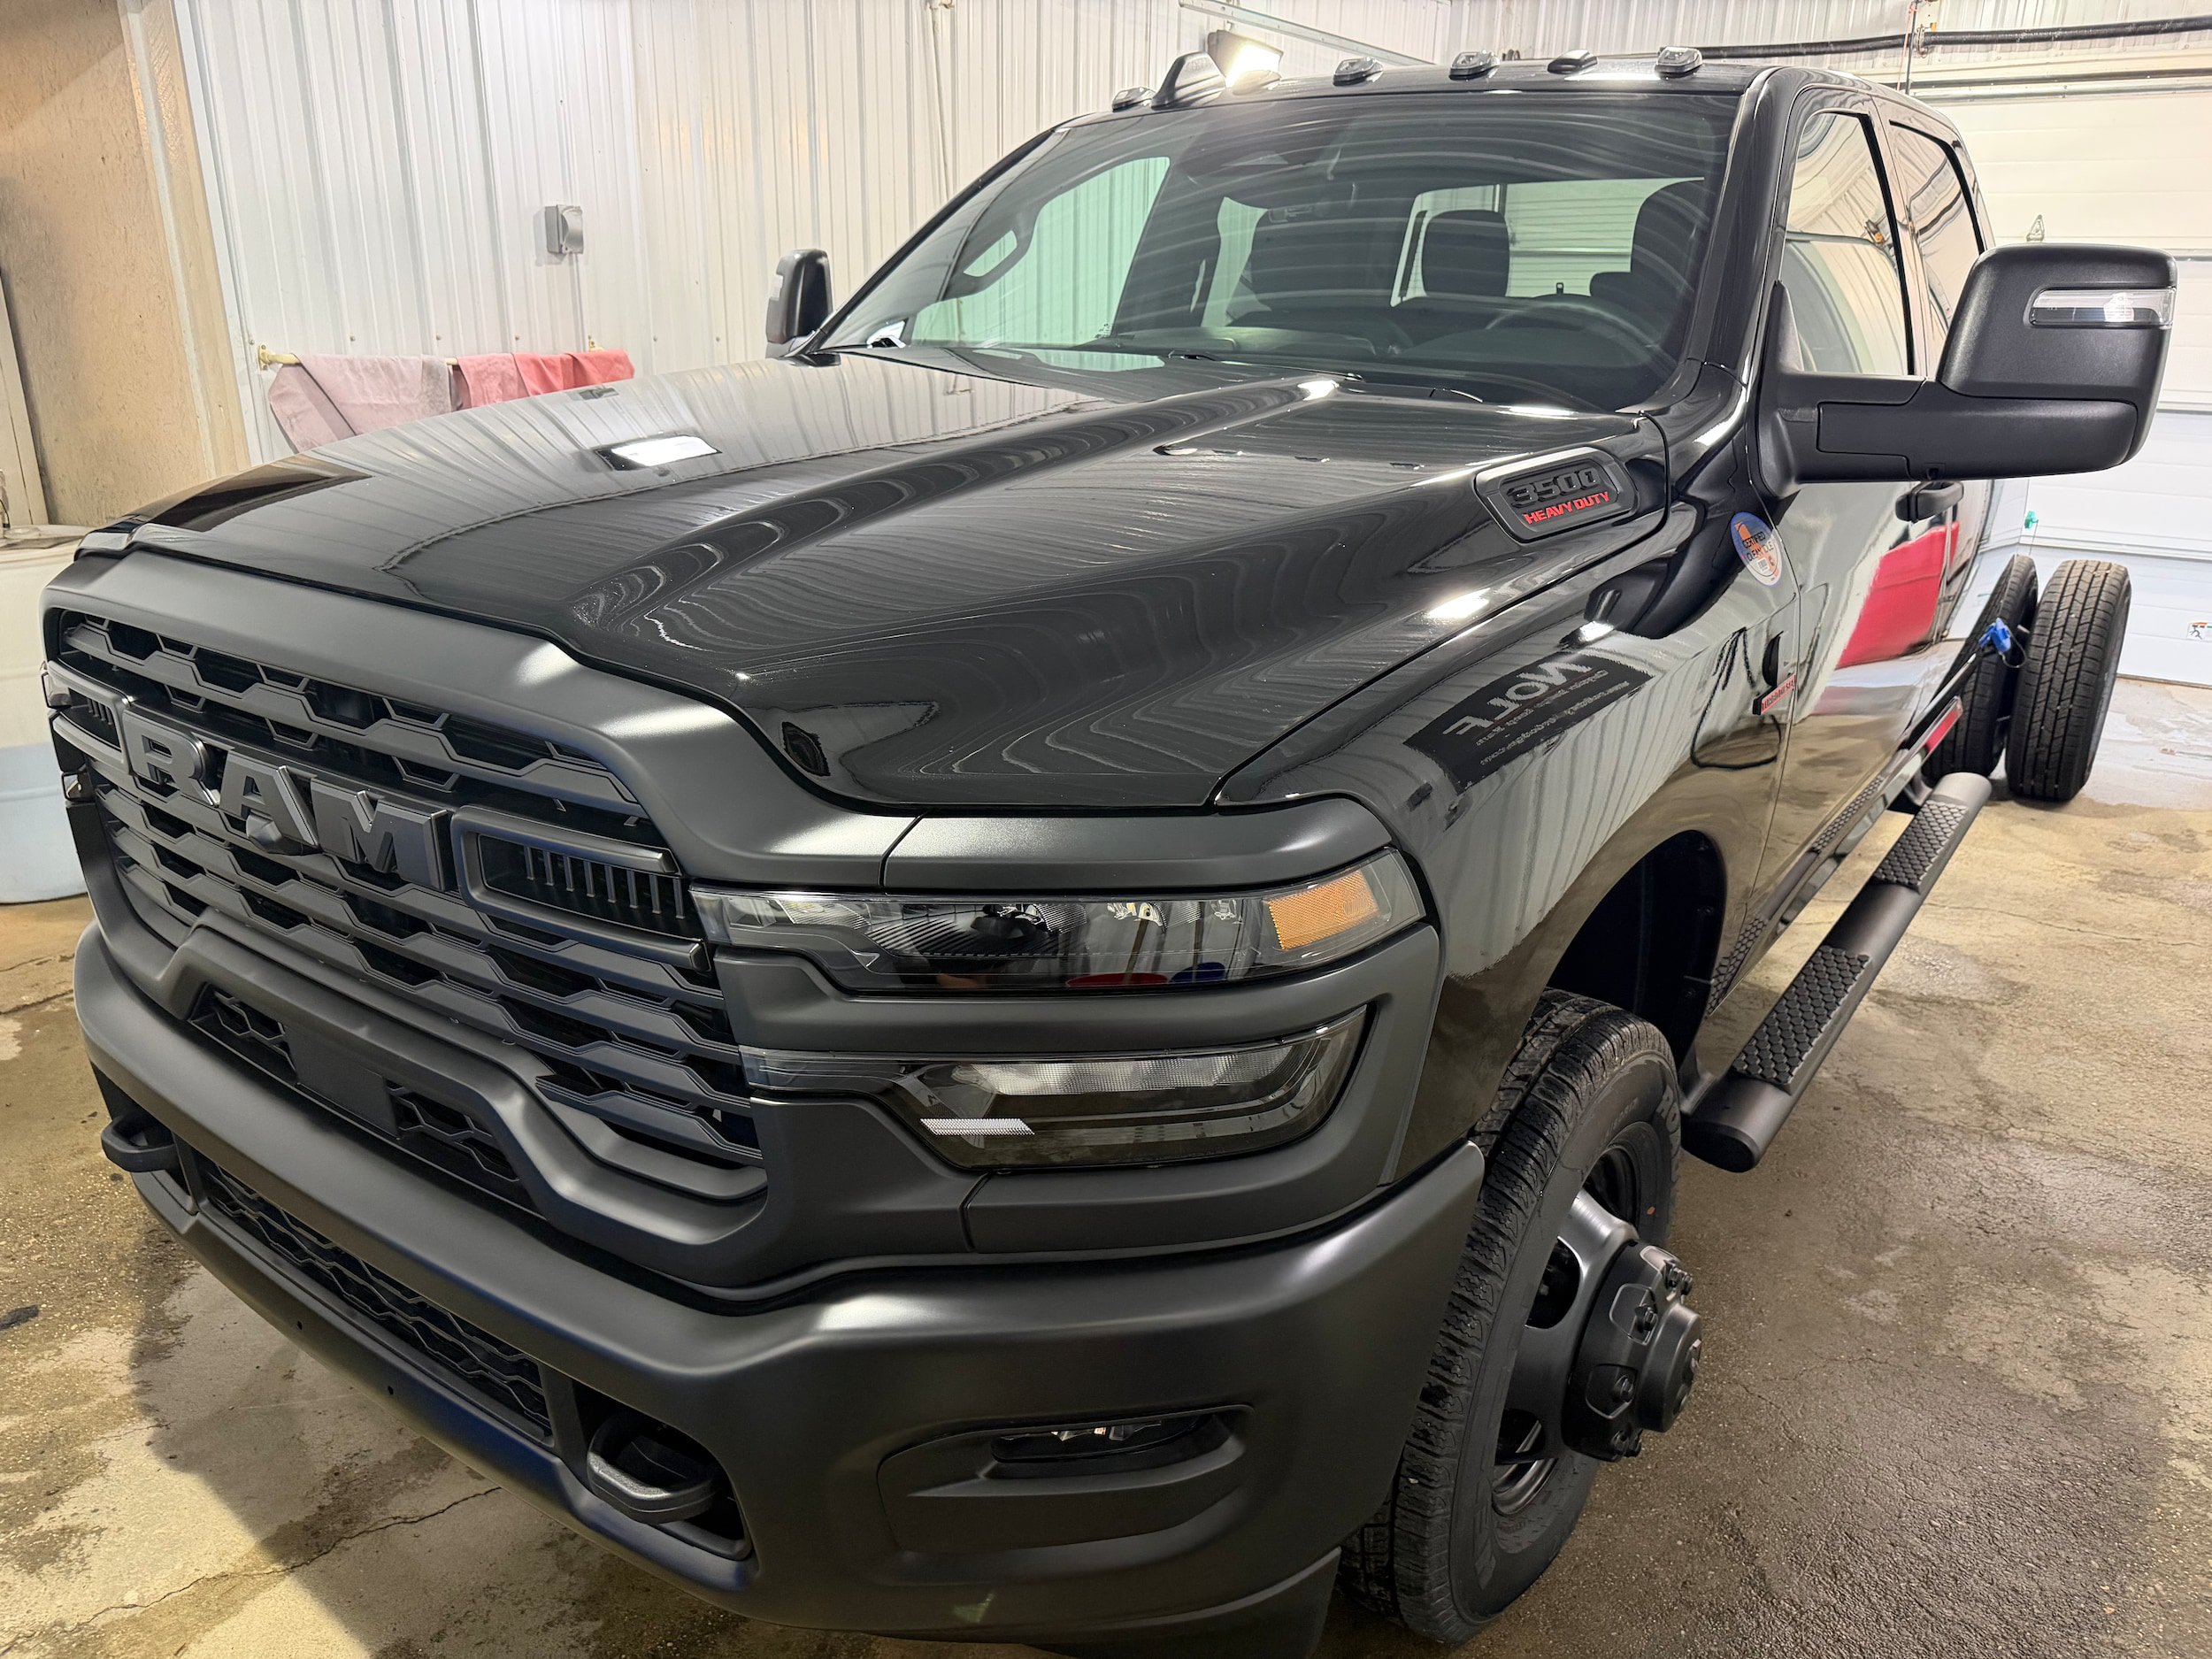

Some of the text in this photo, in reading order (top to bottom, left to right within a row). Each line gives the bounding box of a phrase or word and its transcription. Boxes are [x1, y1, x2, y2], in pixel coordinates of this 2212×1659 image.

[1507, 467, 1600, 508] 3500
[1523, 491, 1610, 525] HEAVY DUTY
[1742, 531, 1766, 549] CERTIFIED
[122, 710, 449, 891] RAM
